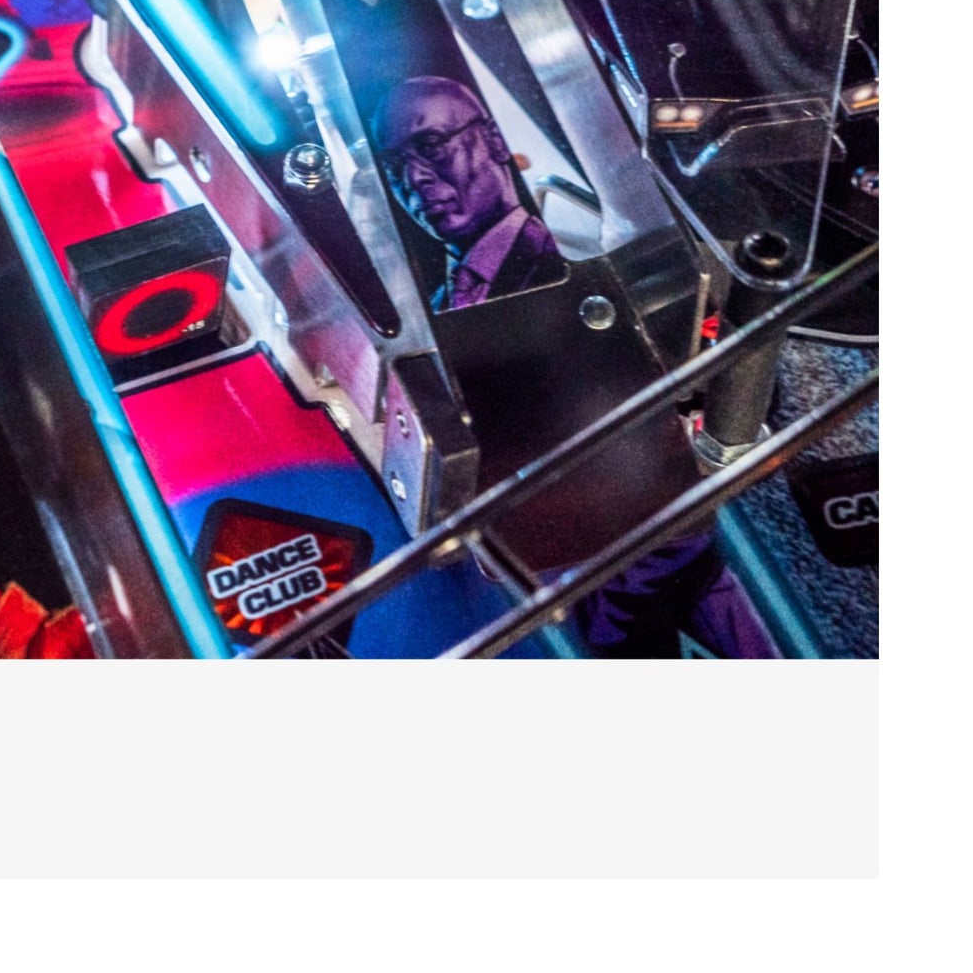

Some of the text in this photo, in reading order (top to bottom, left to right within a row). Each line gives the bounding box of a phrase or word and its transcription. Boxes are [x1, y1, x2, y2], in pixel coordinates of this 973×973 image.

[825, 493, 879, 528] CA
[210, 535, 320, 596] DANCE
[241, 567, 325, 617] CLUB
